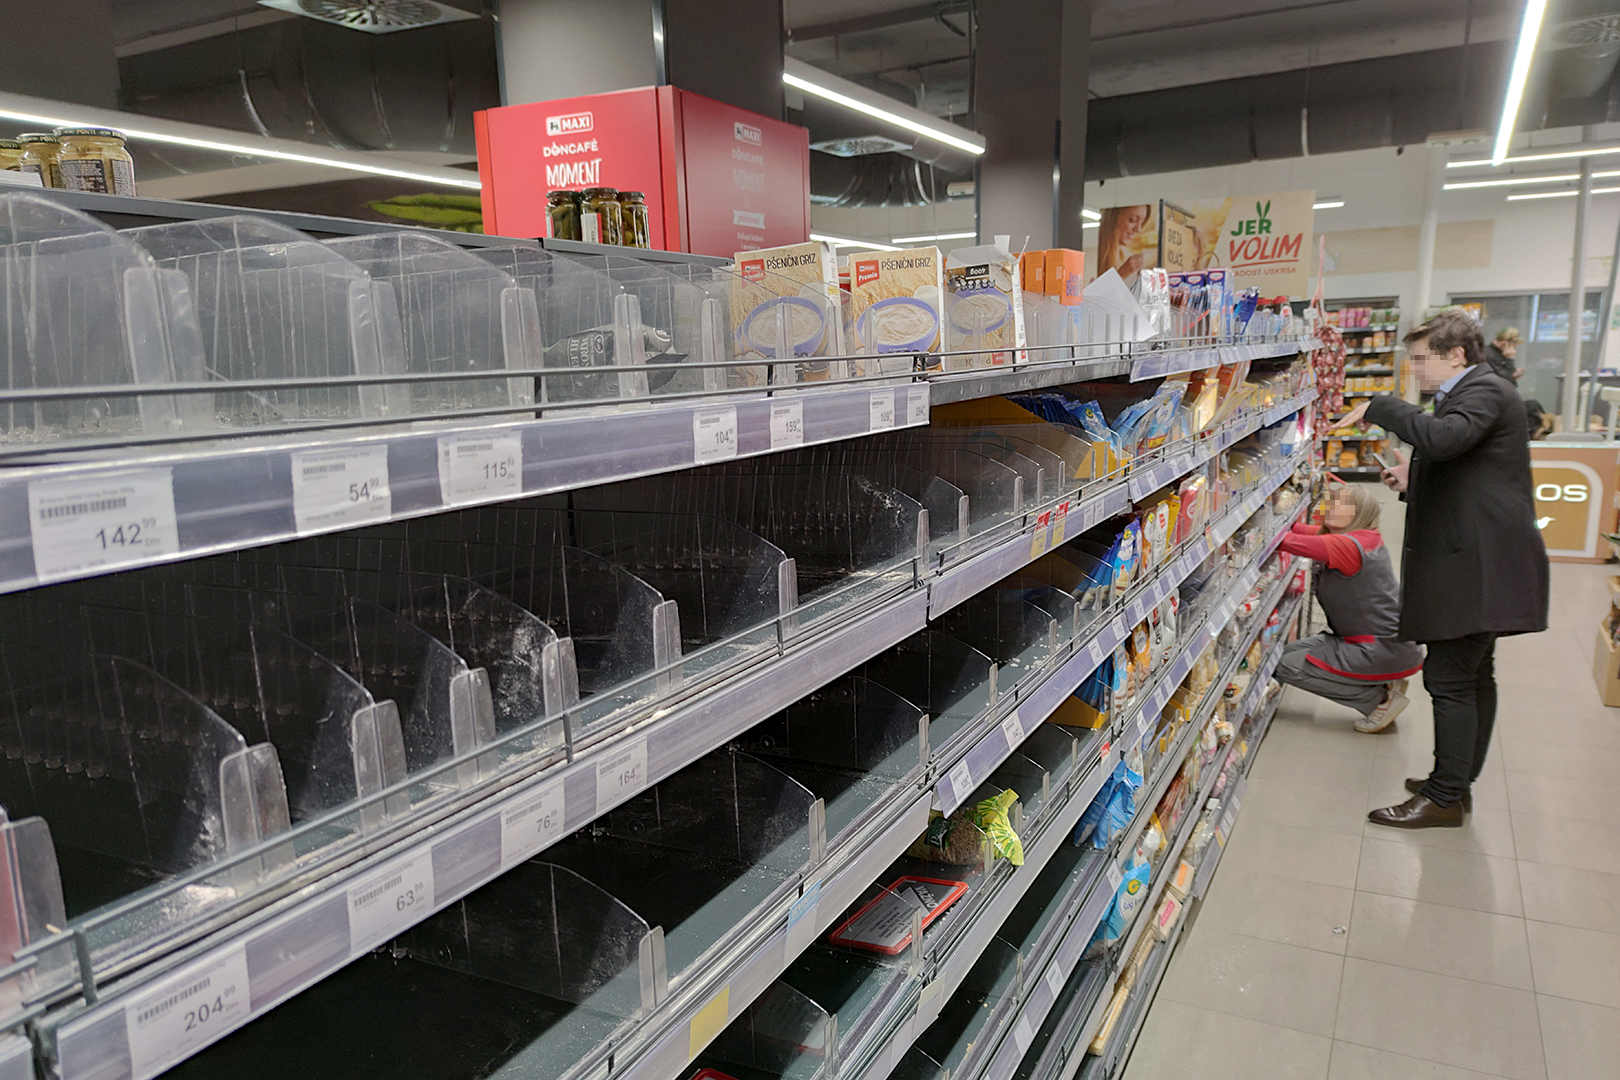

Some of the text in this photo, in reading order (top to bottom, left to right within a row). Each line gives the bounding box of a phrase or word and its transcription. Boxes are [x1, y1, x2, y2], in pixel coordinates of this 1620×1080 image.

[562, 116, 590, 131] MAXI
[743, 128, 760, 142] MAXI
[546, 158, 602, 188] MOMENT
[1230, 219, 1272, 236] JER
[1230, 232, 1303, 262] VOLIM
[767, 253, 817, 270] PŠENIČNI GRIZ
[882, 257, 931, 271] PŠENIČNI GRIZ
[1234, 269, 1261, 277] ADOST
[785, 421, 797, 433] 159
[715, 431, 729, 445] 104
[483, 462, 507, 479] 115
[349, 481, 370, 502] 54
[1535, 484, 1588, 502] OS
[96, 517, 157, 550] 142 99
[619, 767, 636, 787] 164
[536, 814, 551, 833] 76
[396, 890, 415, 911] 63
[915, 885, 939, 909] VAŽNO
[184, 995, 224, 1034] 204
[224, 985, 236, 998] 99
